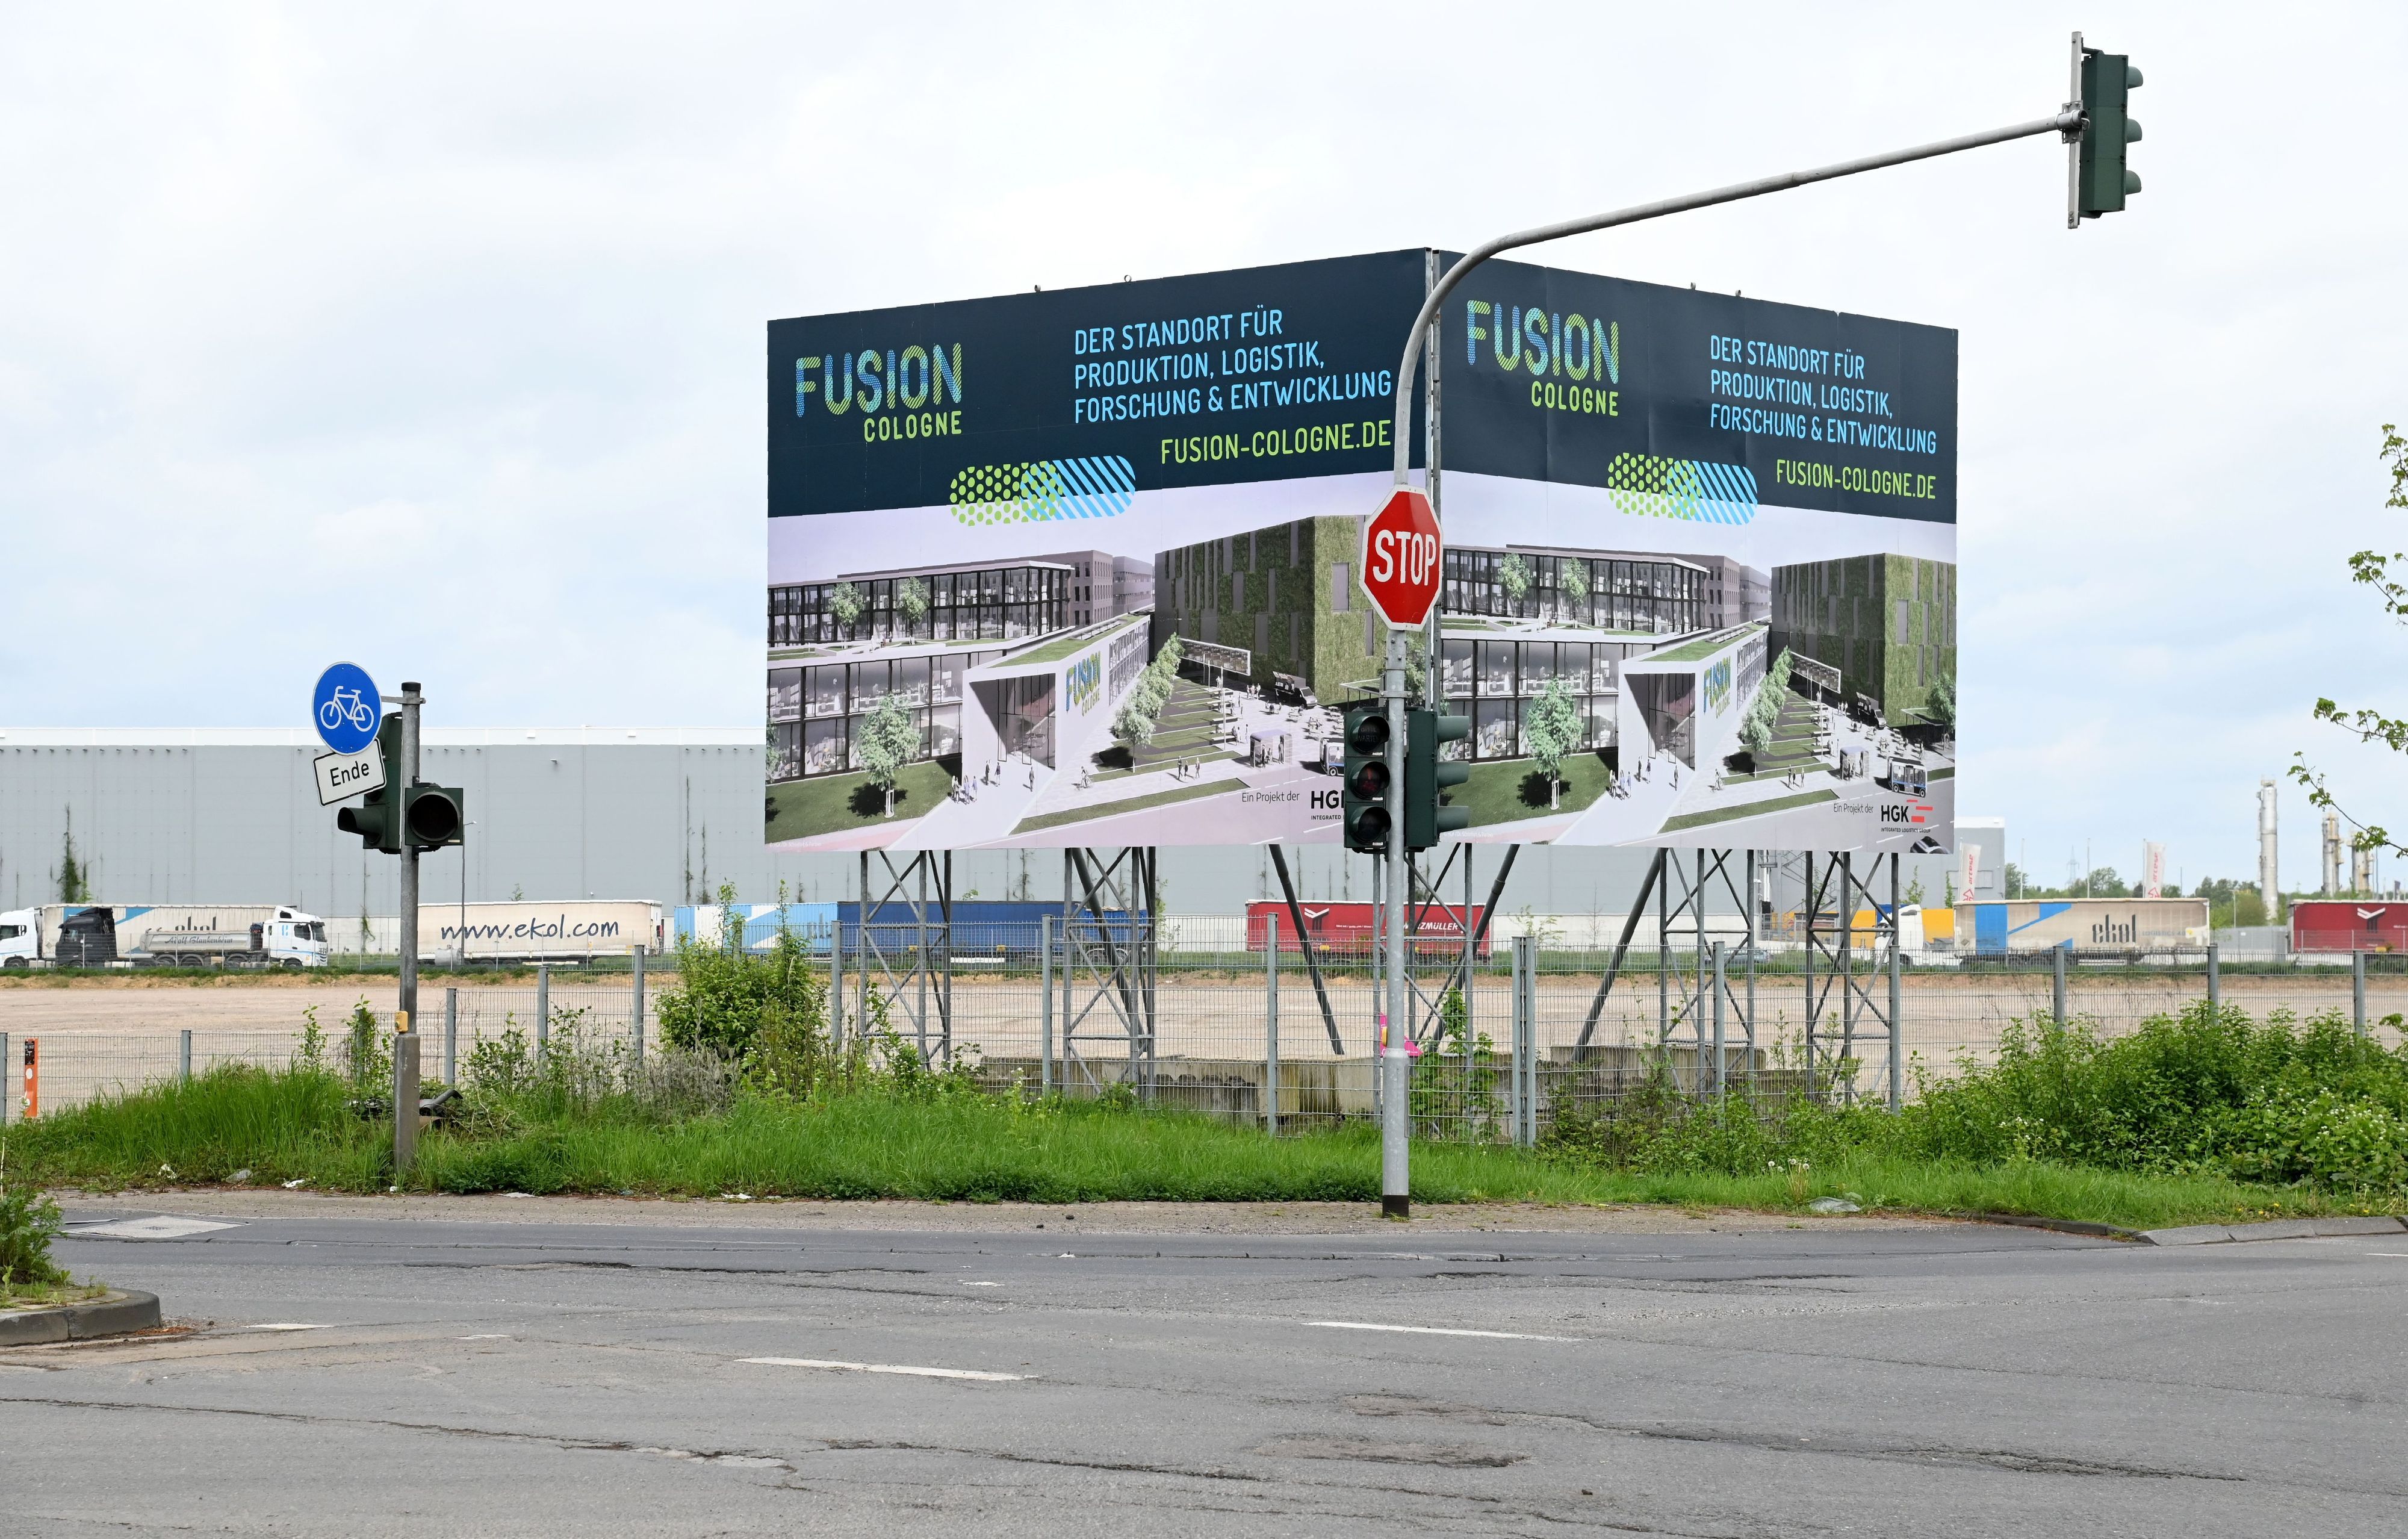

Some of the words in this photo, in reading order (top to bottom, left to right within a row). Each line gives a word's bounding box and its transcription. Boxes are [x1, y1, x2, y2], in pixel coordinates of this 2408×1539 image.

[1075, 328, 1115, 355] DER
[1122, 314, 1233, 350] STANDORT
[1240, 304, 1283, 338] FÜR
[1467, 300, 1619, 385] FUSION
[1075, 352, 1214, 390] PRODUKTION,
[1222, 341, 1324, 376] LOGISTIK,
[1710, 335, 1742, 364] DER
[1747, 341, 1830, 375] STANDORT
[1834, 349, 1865, 380] FÜR
[796, 343, 962, 418] FUSION
[1075, 388, 1201, 424] FORSCHUNG
[1208, 386, 1224, 412] &
[1230, 370, 1391, 410] ENTWICKLUNG
[1531, 381, 1619, 417] COLOGNE
[1710, 369, 1816, 410] PRODUKTION,
[1821, 384, 1893, 420] LOGISTIK,
[864, 411, 962, 443] COLOGNE
[1161, 420, 1391, 464] FUSION-COLOGNE.DE
[1710, 403, 1807, 440] FORSCHUNG
[1810, 416, 1822, 441] &
[1827, 418, 1937, 455] ENTWICKLUNG
[1777, 459, 1937, 499] FUSION-COLOGNE.DE
[1373, 529, 1436, 586] STOP
[329, 760, 370, 788] Ende
[1242, 792, 1254, 802] Ein
[1256, 791, 1285, 804] Projekt
[1286, 791, 1300, 801] der
[1311, 790, 1344, 809] HG
[1833, 803, 1843, 813] Ein
[1843, 803, 1864, 815] Projekt
[1864, 804, 1874, 813] der
[1881, 805, 1910, 822] HGK
[441, 913, 619, 939] www.ekol.com
